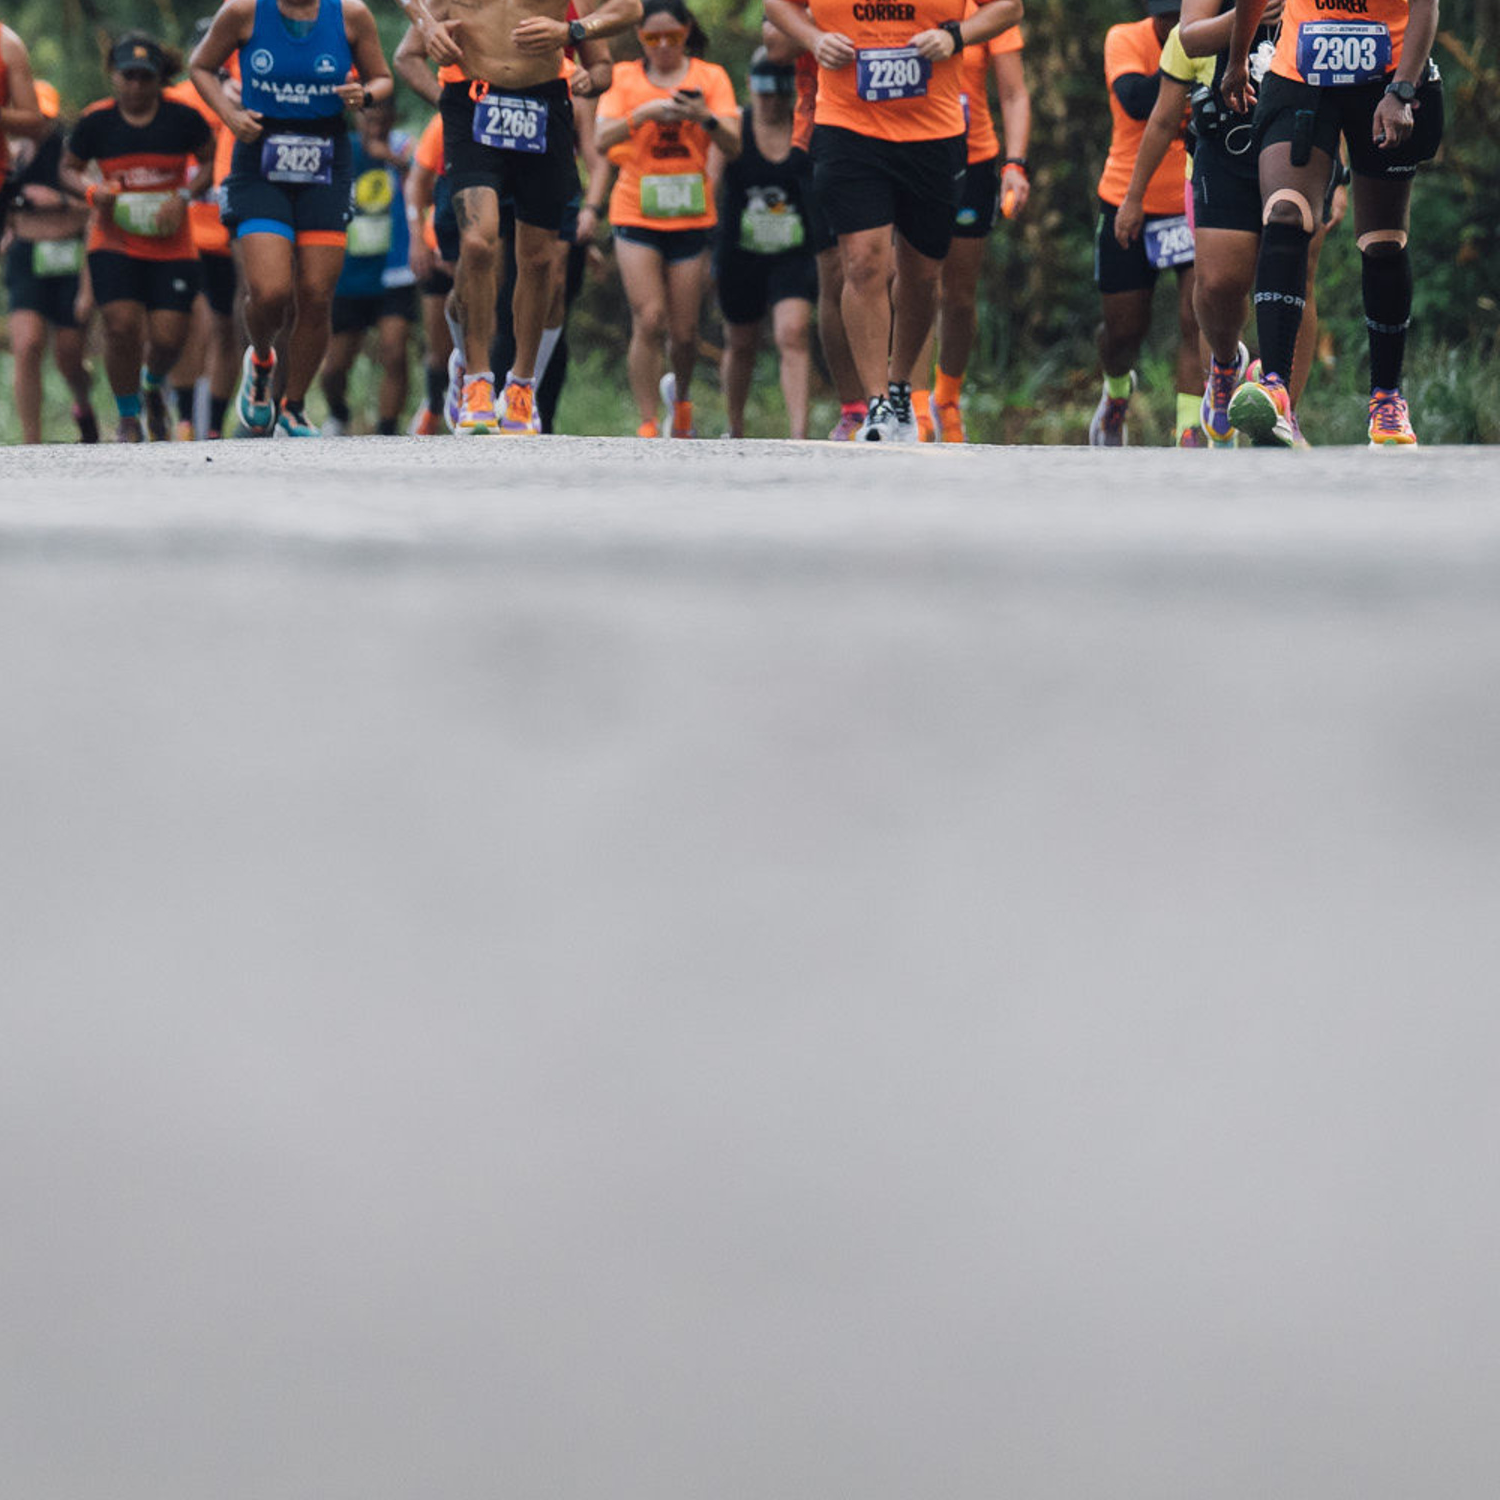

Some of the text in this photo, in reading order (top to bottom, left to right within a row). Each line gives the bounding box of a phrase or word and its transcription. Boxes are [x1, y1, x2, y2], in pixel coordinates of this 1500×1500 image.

[853, 3, 916, 22] CORRER
[1312, 36, 1377, 71] 2303
[868, 58, 921, 89] 2280
[485, 106, 538, 140] 2266
[275, 144, 322, 172] 2423
